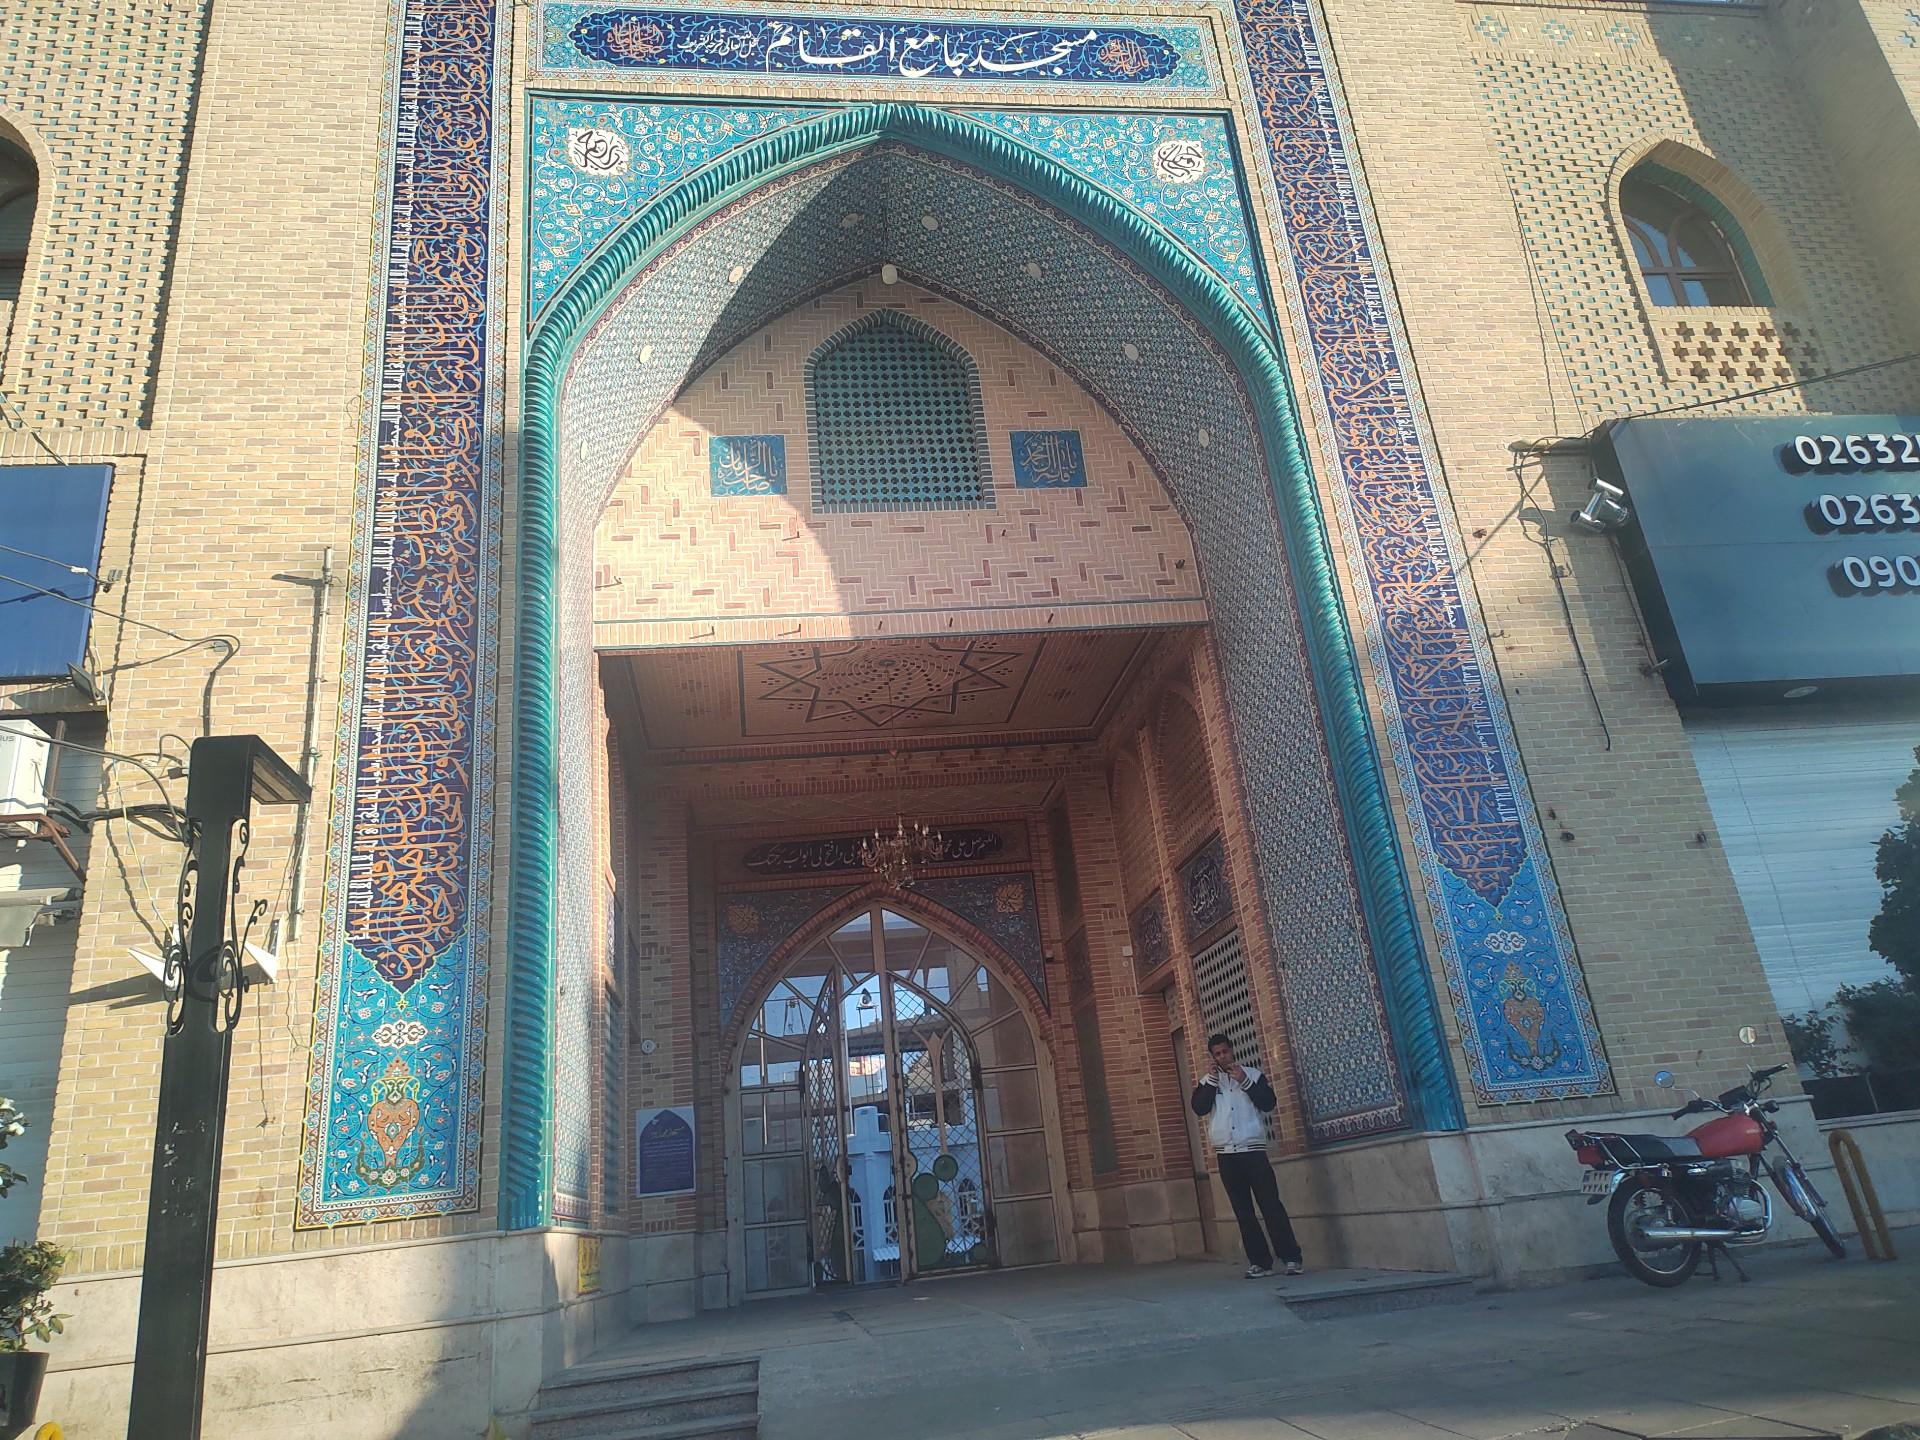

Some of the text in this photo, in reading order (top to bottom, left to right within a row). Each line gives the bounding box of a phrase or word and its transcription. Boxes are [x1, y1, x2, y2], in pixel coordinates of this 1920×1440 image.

[765, 21, 1098, 78] مسجد جامع القائم
[1794, 434, 1920, 465] 02632
[1819, 493, 1920, 525] 0263
